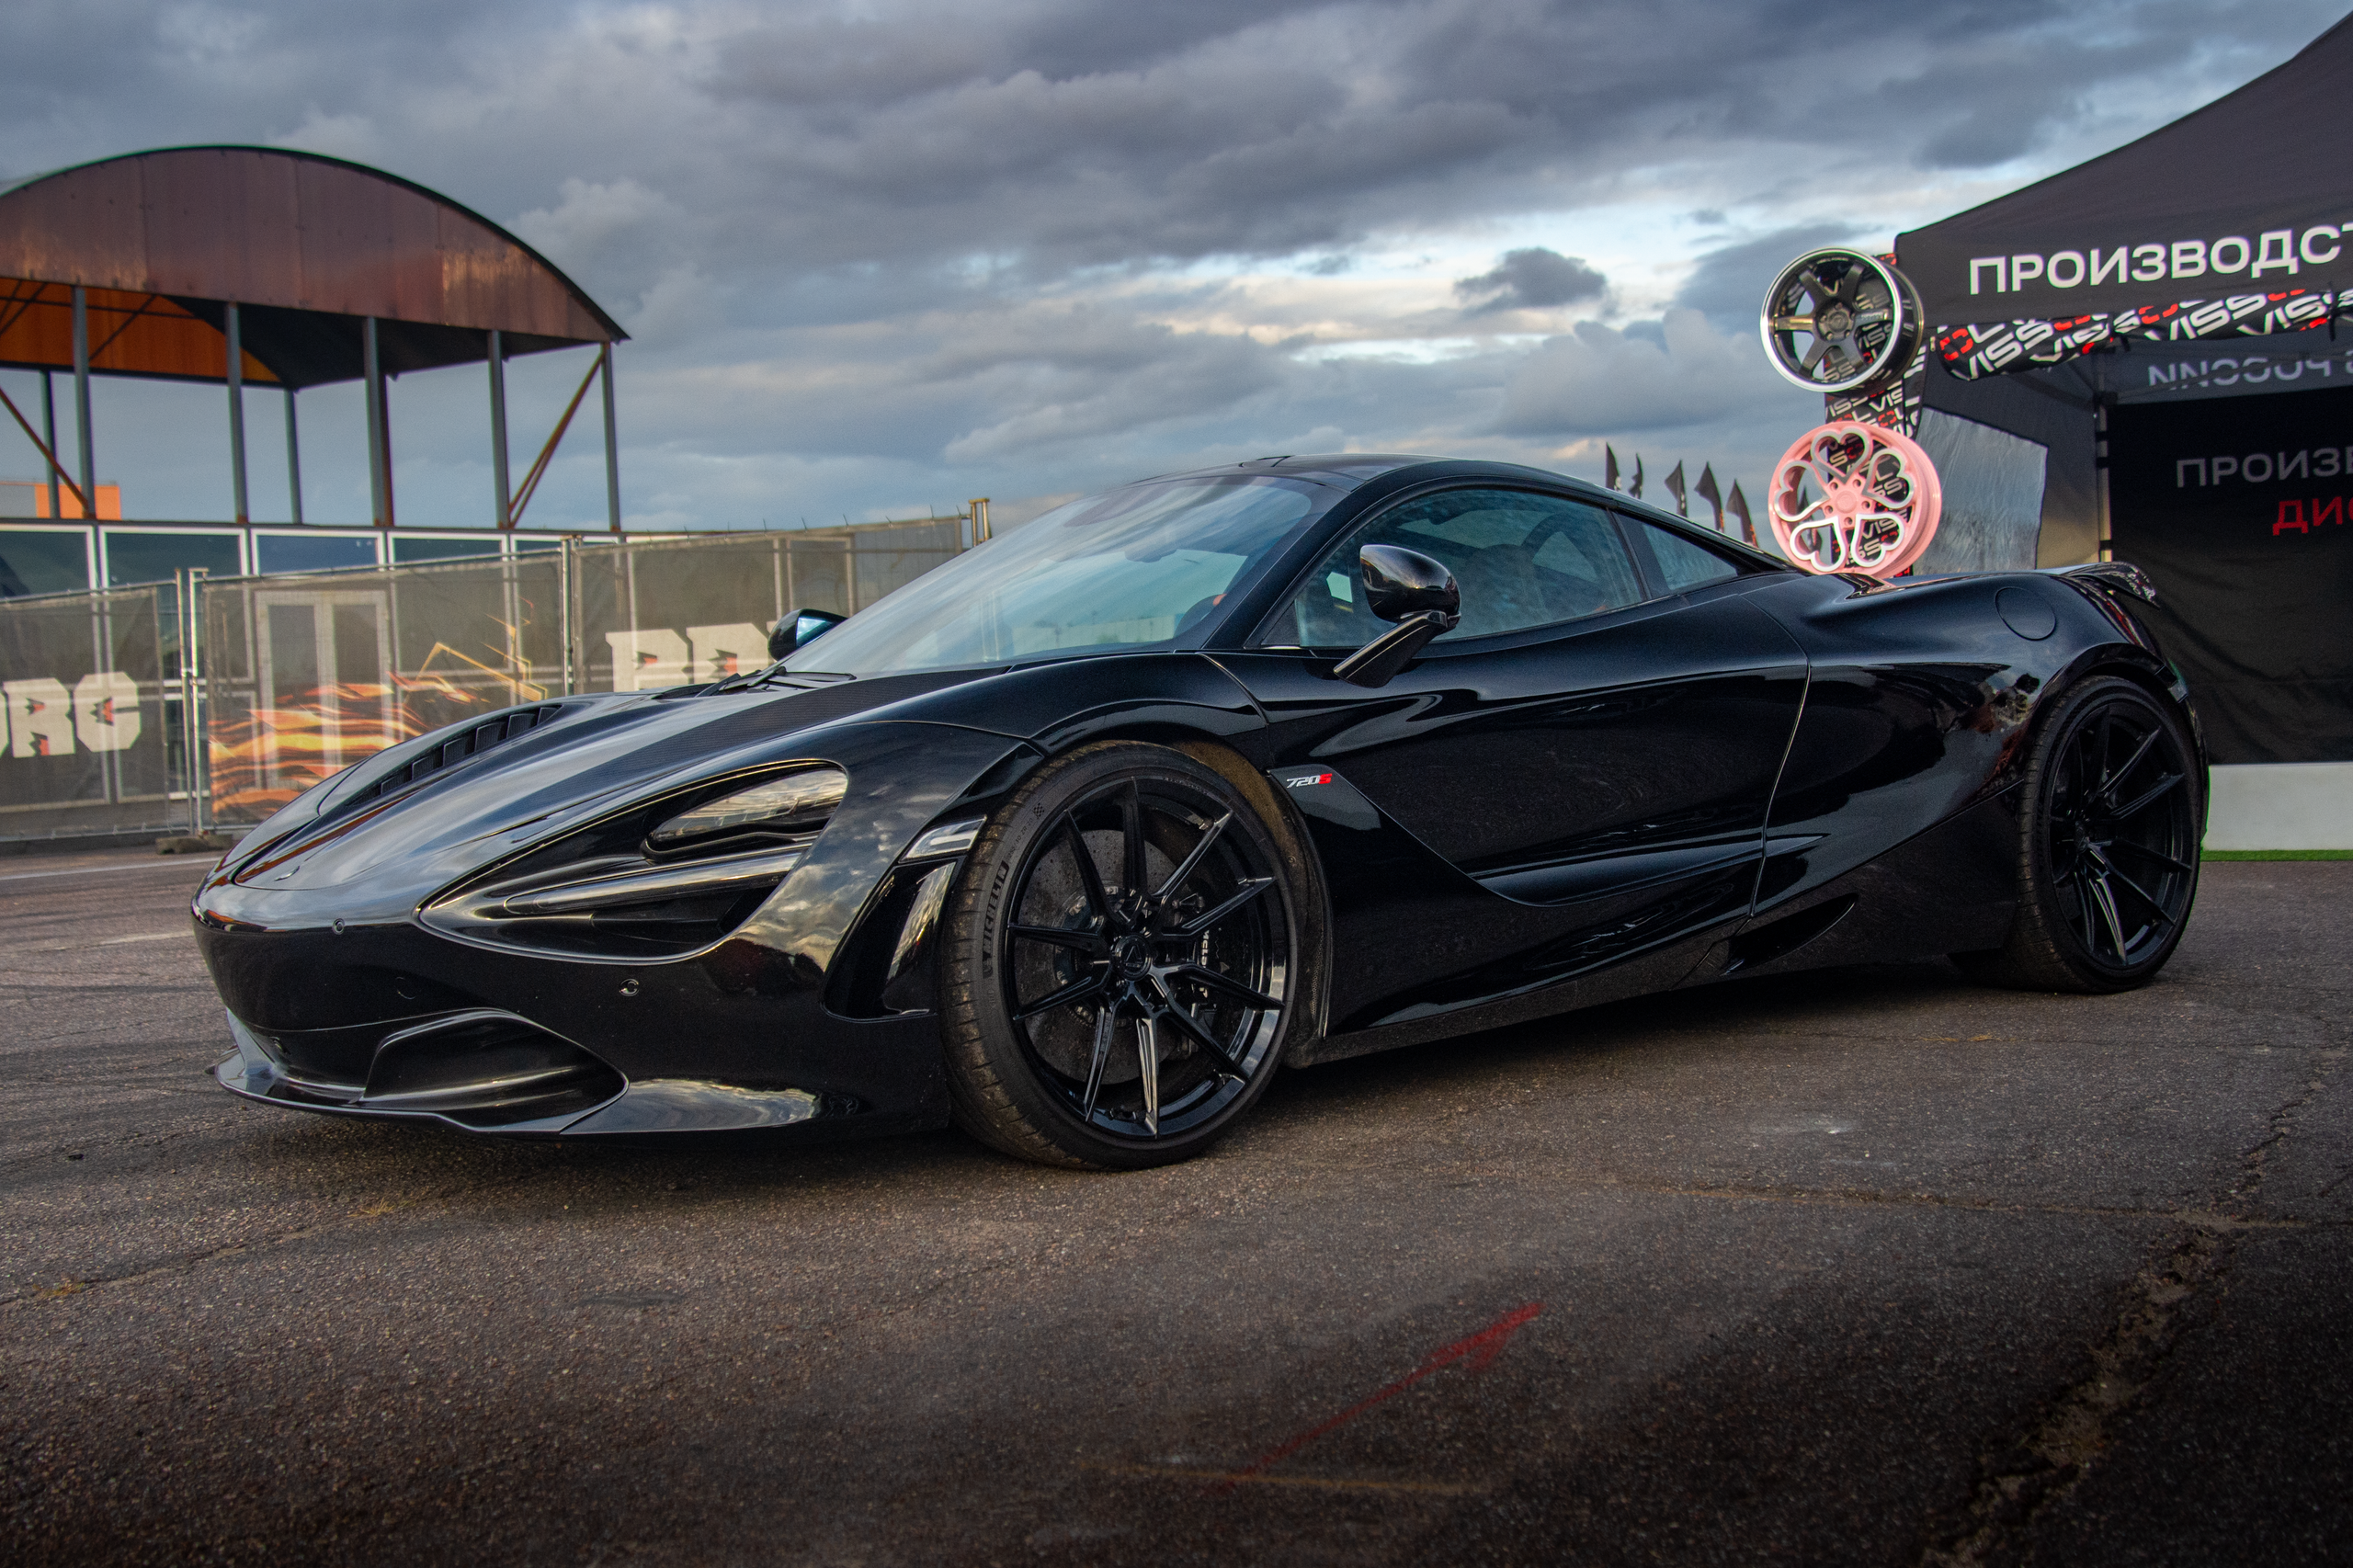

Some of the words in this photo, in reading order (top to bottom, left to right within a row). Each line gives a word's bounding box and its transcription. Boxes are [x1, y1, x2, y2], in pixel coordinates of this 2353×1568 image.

[2177, 446, 2353, 488] ПРОИЗ
[2272, 495, 2353, 536] ДИ
[1286, 773, 1333, 789] 720S
[982, 863, 1010, 956] MICHELIN
